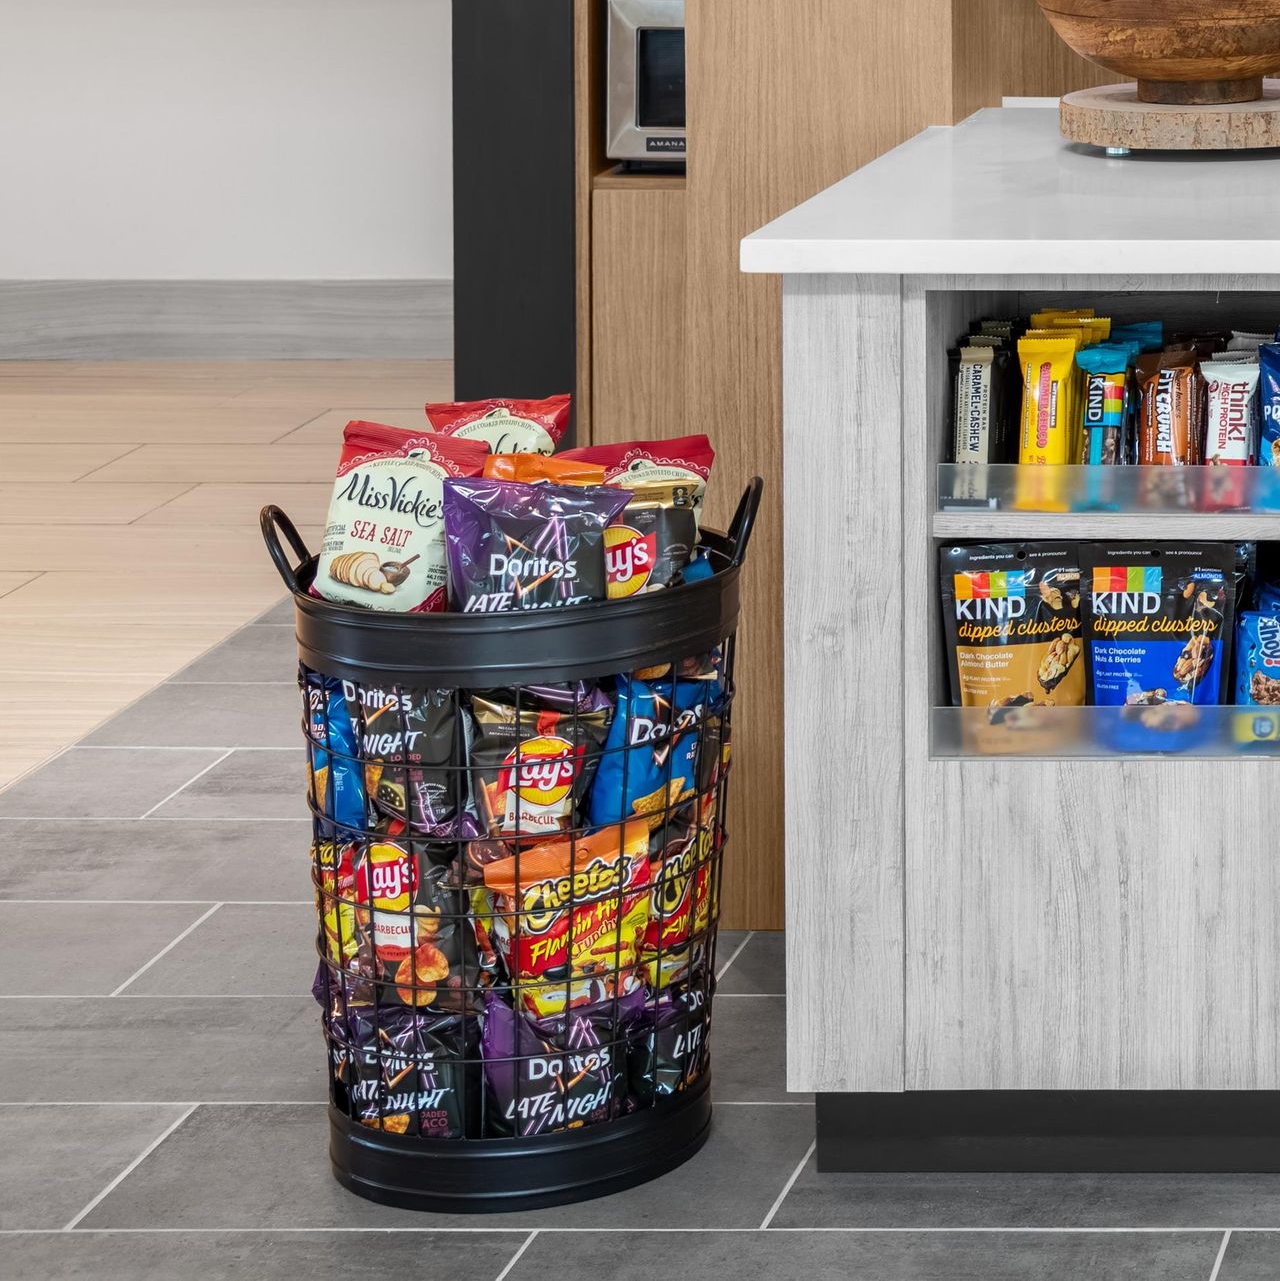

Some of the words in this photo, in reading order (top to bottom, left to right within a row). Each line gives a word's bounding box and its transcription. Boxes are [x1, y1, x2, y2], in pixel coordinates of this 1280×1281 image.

[1088, 377, 1104, 421] KIND
[1221, 382, 1231, 405] HIGH
[1228, 381, 1249, 442] think!
[1218, 407, 1228, 450] PROTEIN
[337, 473, 388, 509] Miss
[387, 476, 446, 527] Vickie's
[351, 520, 374, 541] SEA
[381, 527, 412, 548] SALT
[490, 553, 577, 579] Doritos
[955, 596, 1026, 620] KIND
[1092, 592, 1161, 614] KIND
[959, 622, 1015, 642] dipped
[1017, 617, 1082, 637] clusters
[1093, 616, 1149, 636] dipped
[1152, 616, 1218, 633] clusters
[976, 652, 1014, 660] Chocolate
[1094, 647, 1107, 655] Dark
[1108, 647, 1146, 655] Chocolate
[1115, 655, 1142, 663] Berries
[985, 660, 1009, 668] Butter
[508, 746, 575, 788] Lay's
[508, 809, 556, 826] BARBECUE
